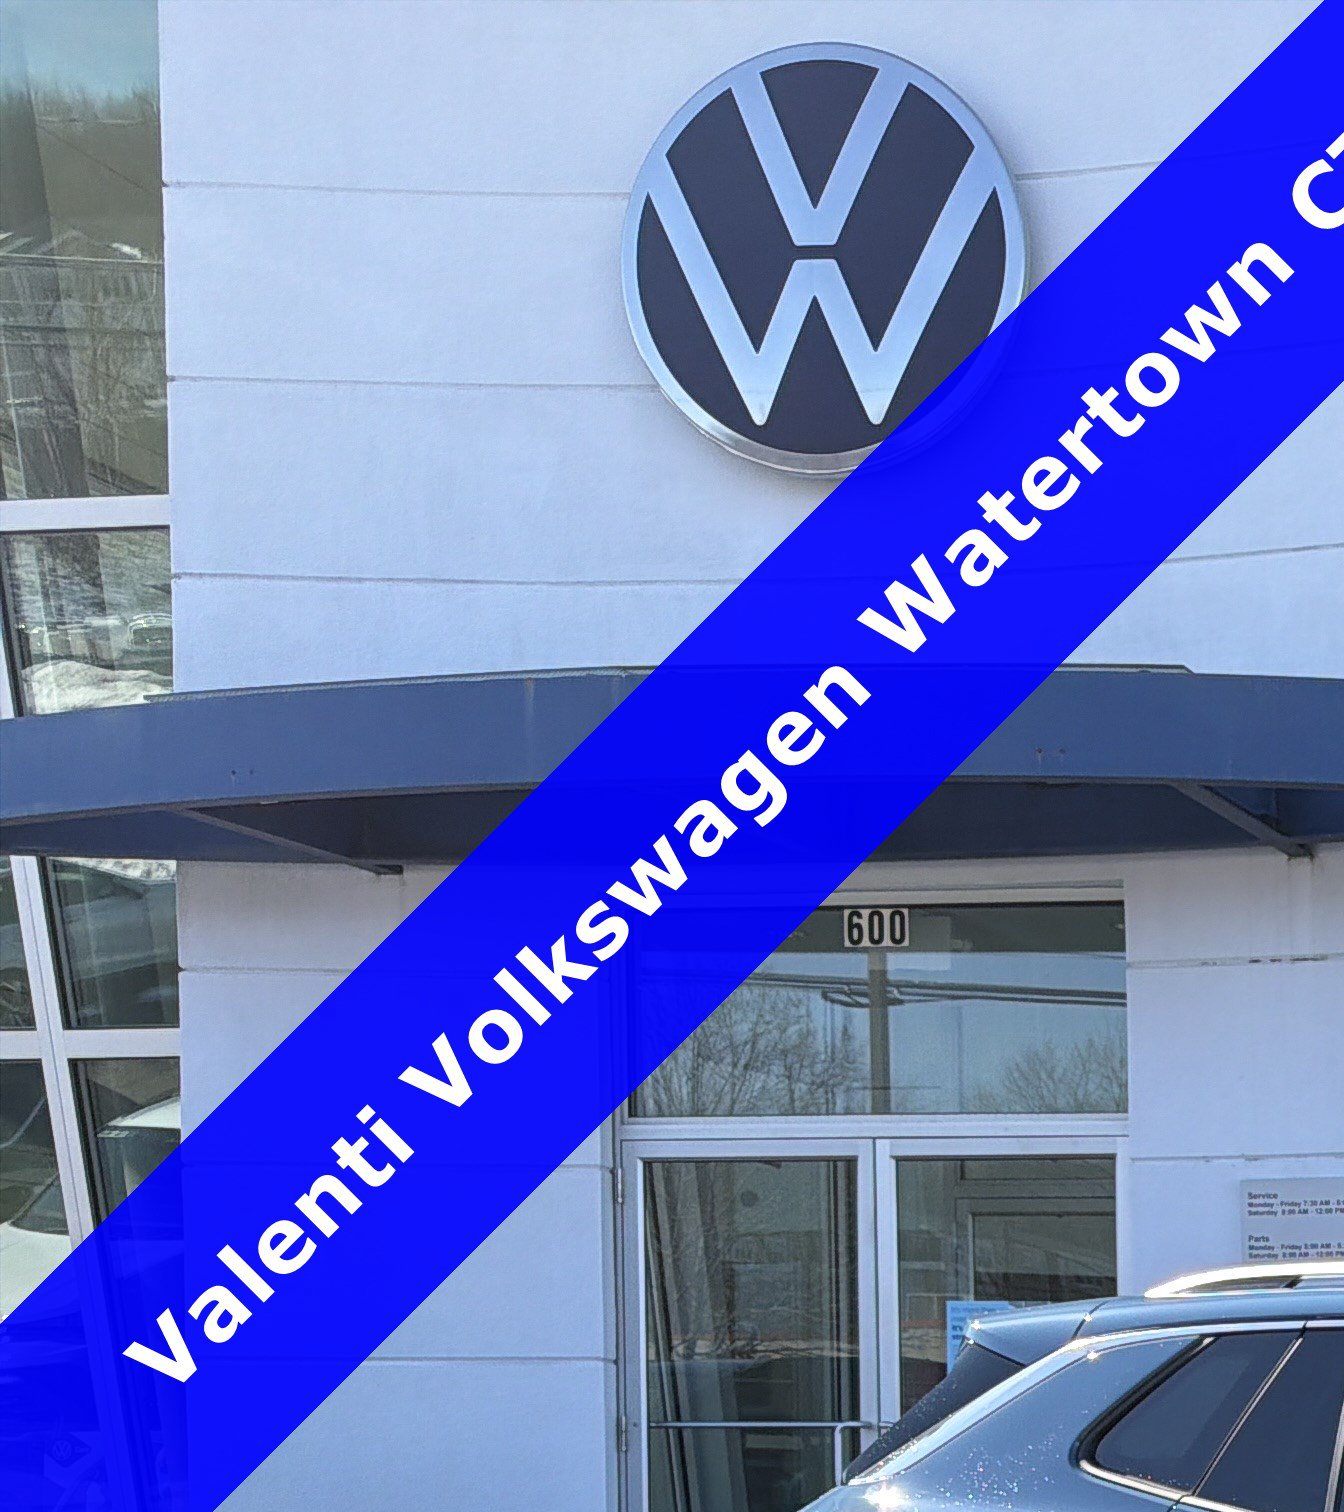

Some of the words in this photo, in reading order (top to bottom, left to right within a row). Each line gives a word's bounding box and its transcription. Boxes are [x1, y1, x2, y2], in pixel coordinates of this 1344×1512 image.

[847, 909, 906, 946] 600
[1247, 1192, 1278, 1200] Service
[1247, 1201, 1275, 1209] Monday
[1280, 1200, 1301, 1208] Friday
[1247, 1209, 1278, 1217] Saturday
[1297, 1207, 1309, 1215] AM
[1248, 1234, 1270, 1243] Parts
[1248, 1244, 1275, 1252] Monday
[1280, 1243, 1302, 1251] Friday
[1248, 1251, 1279, 1260] Saturday
